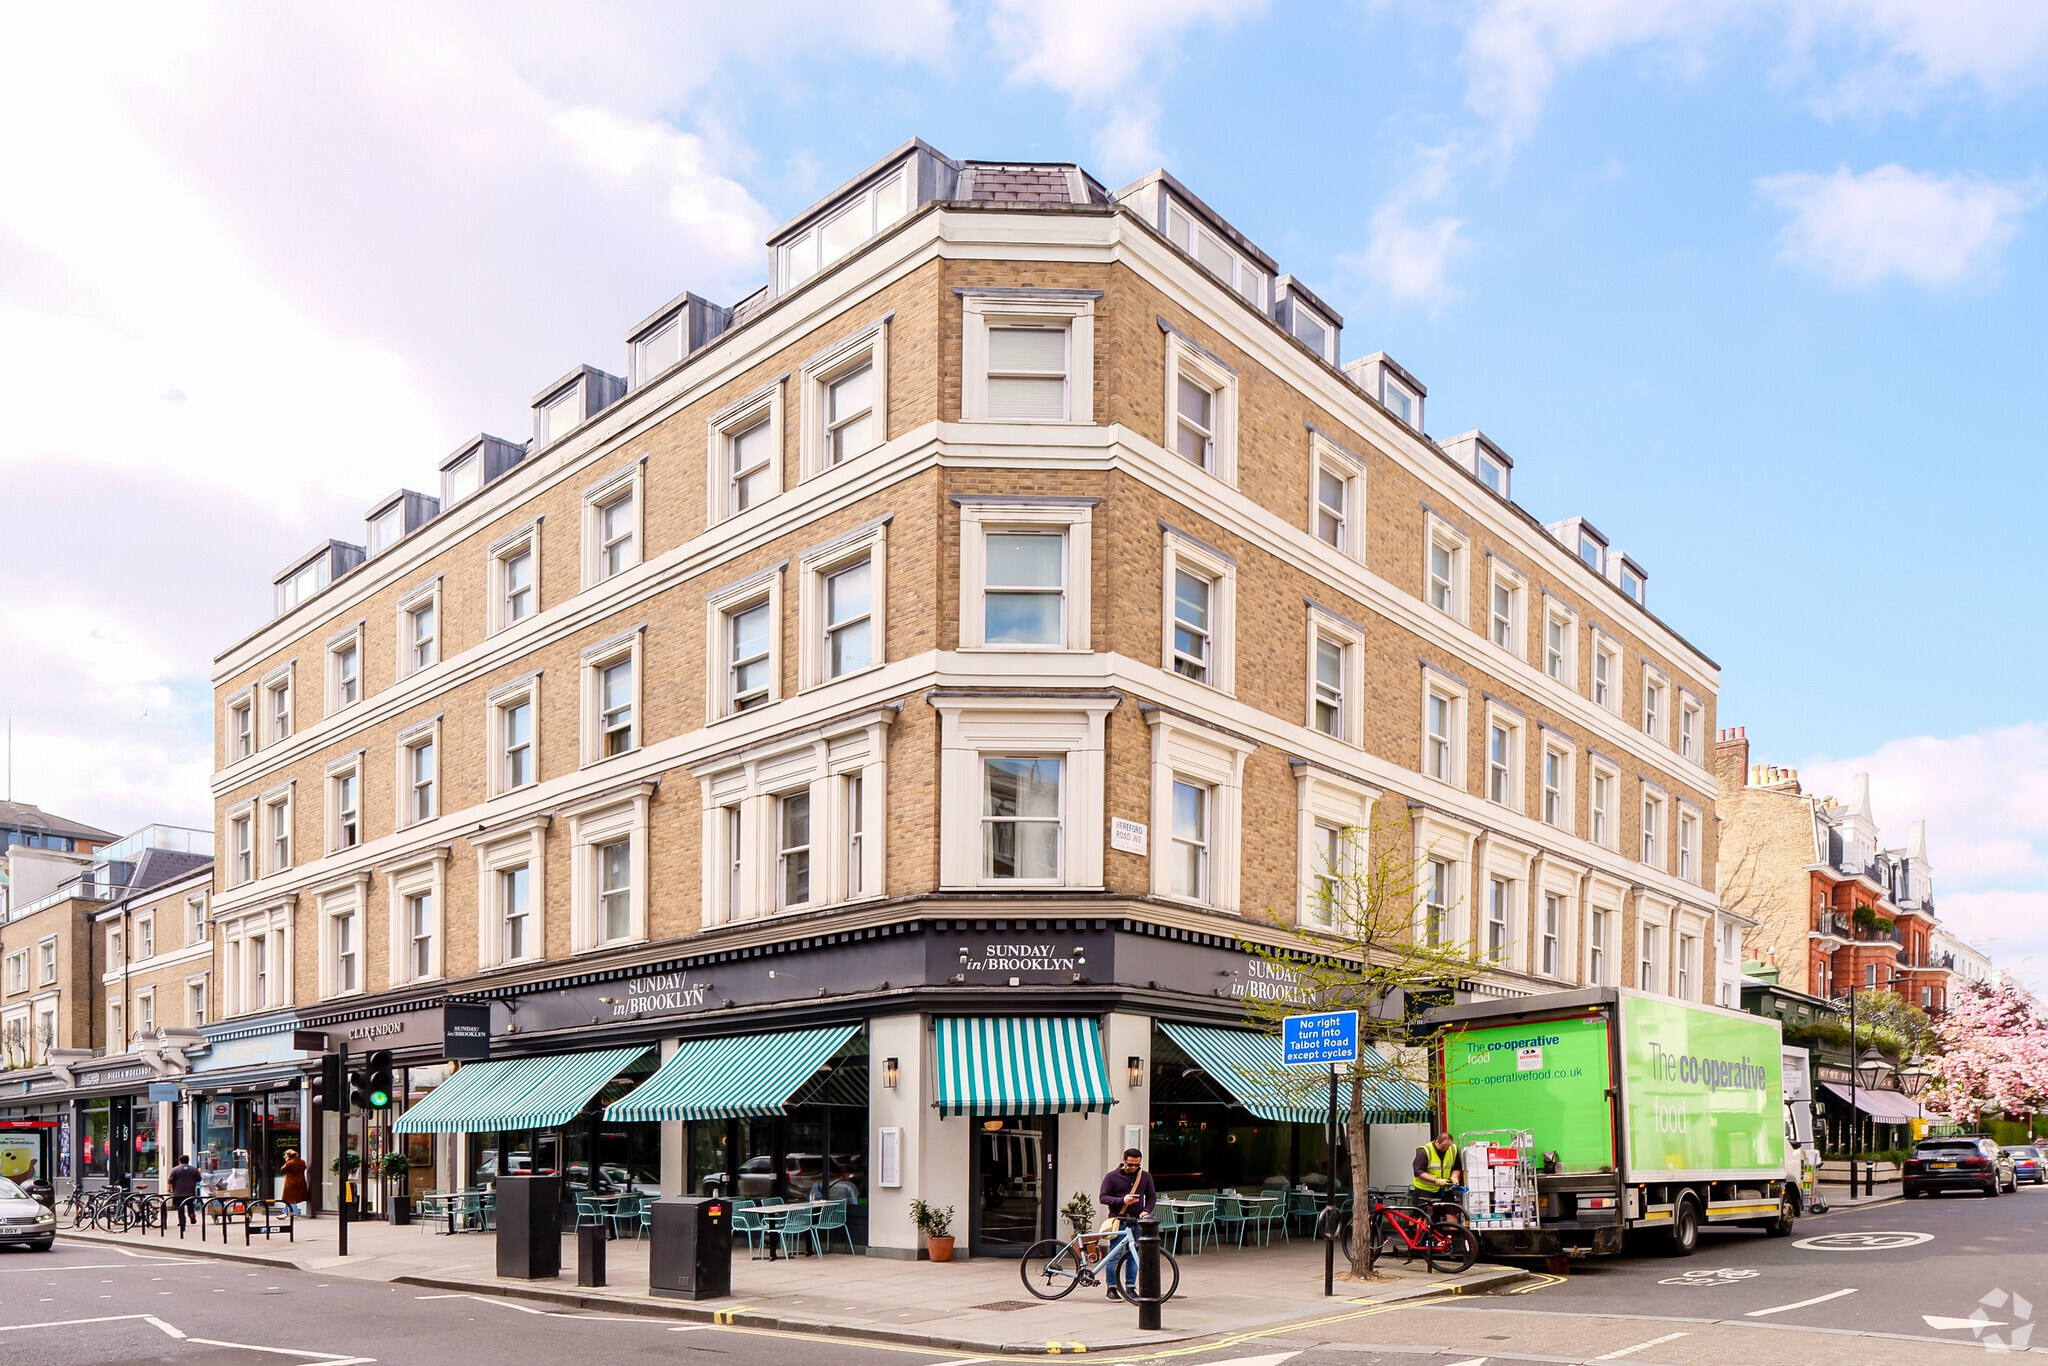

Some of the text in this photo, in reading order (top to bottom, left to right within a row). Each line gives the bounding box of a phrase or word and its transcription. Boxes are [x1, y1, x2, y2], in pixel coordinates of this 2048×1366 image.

[1116, 821, 1143, 835] HEREFORD
[1116, 830, 1142, 844] ROAD W2
[986, 945, 1056, 958] SUNDAY/
[628, 971, 687, 995] SUNDAY/
[1300, 1017, 1340, 1029] No right
[348, 1021, 402, 1041] CLARENDON
[1299, 1028, 1340, 1039] turn into
[1290, 1037, 1349, 1050] Talbot Road
[1467, 1035, 1560, 1053] The co-operative
[1287, 1048, 1352, 1060] except cycles
[1468, 1053, 1490, 1064] food
[1649, 1042, 1766, 1094] The co-operative
[1468, 1067, 1583, 1086] co-operativefood.co.uk
[1654, 1095, 1687, 1134] food
[1820, 1236, 1914, 1246] 20
